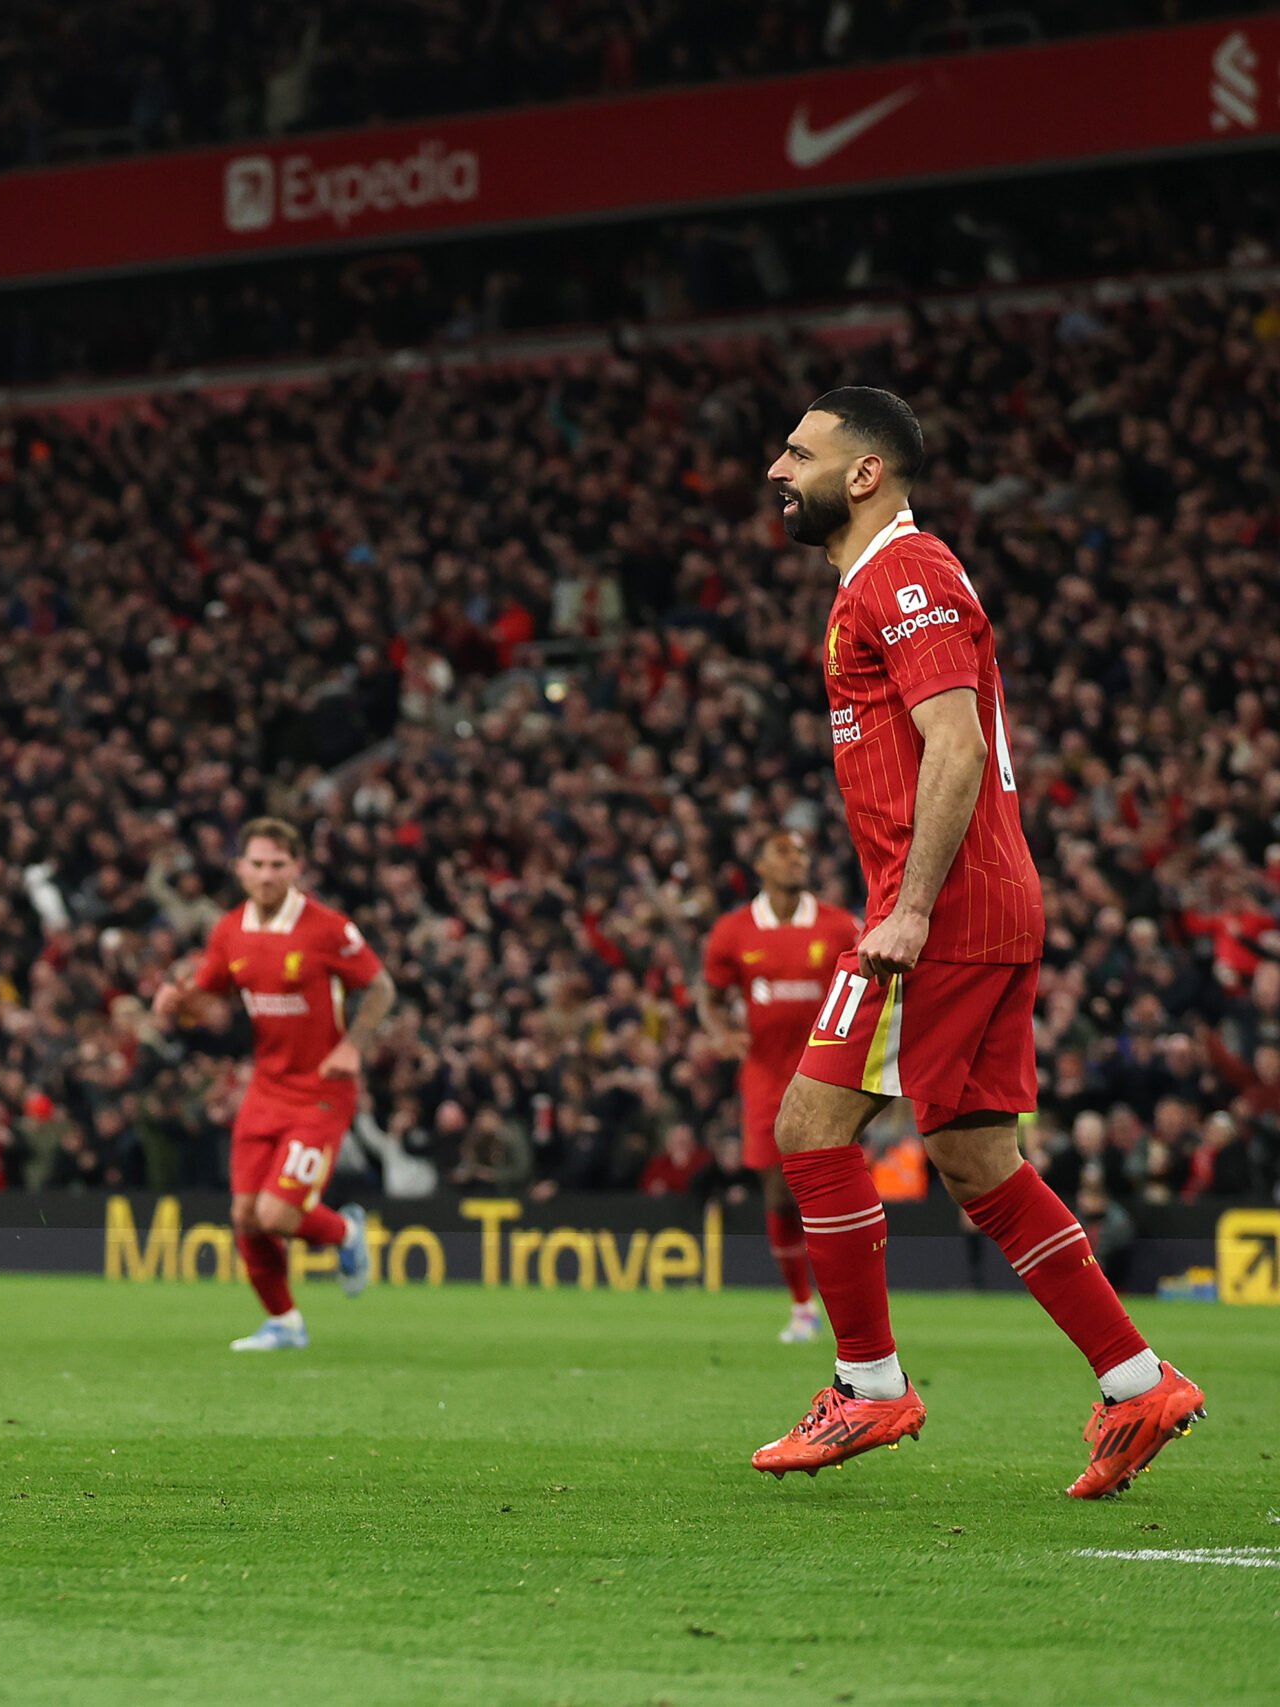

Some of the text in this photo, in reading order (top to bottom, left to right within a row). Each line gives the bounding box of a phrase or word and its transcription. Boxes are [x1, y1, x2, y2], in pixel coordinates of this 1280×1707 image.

[282, 140, 478, 229] Expedia
[881, 605, 960, 646] Expedia
[817, 969, 869, 1038] 11
[285, 1139, 326, 1184] 10
[459, 1197, 724, 1292] Travel
